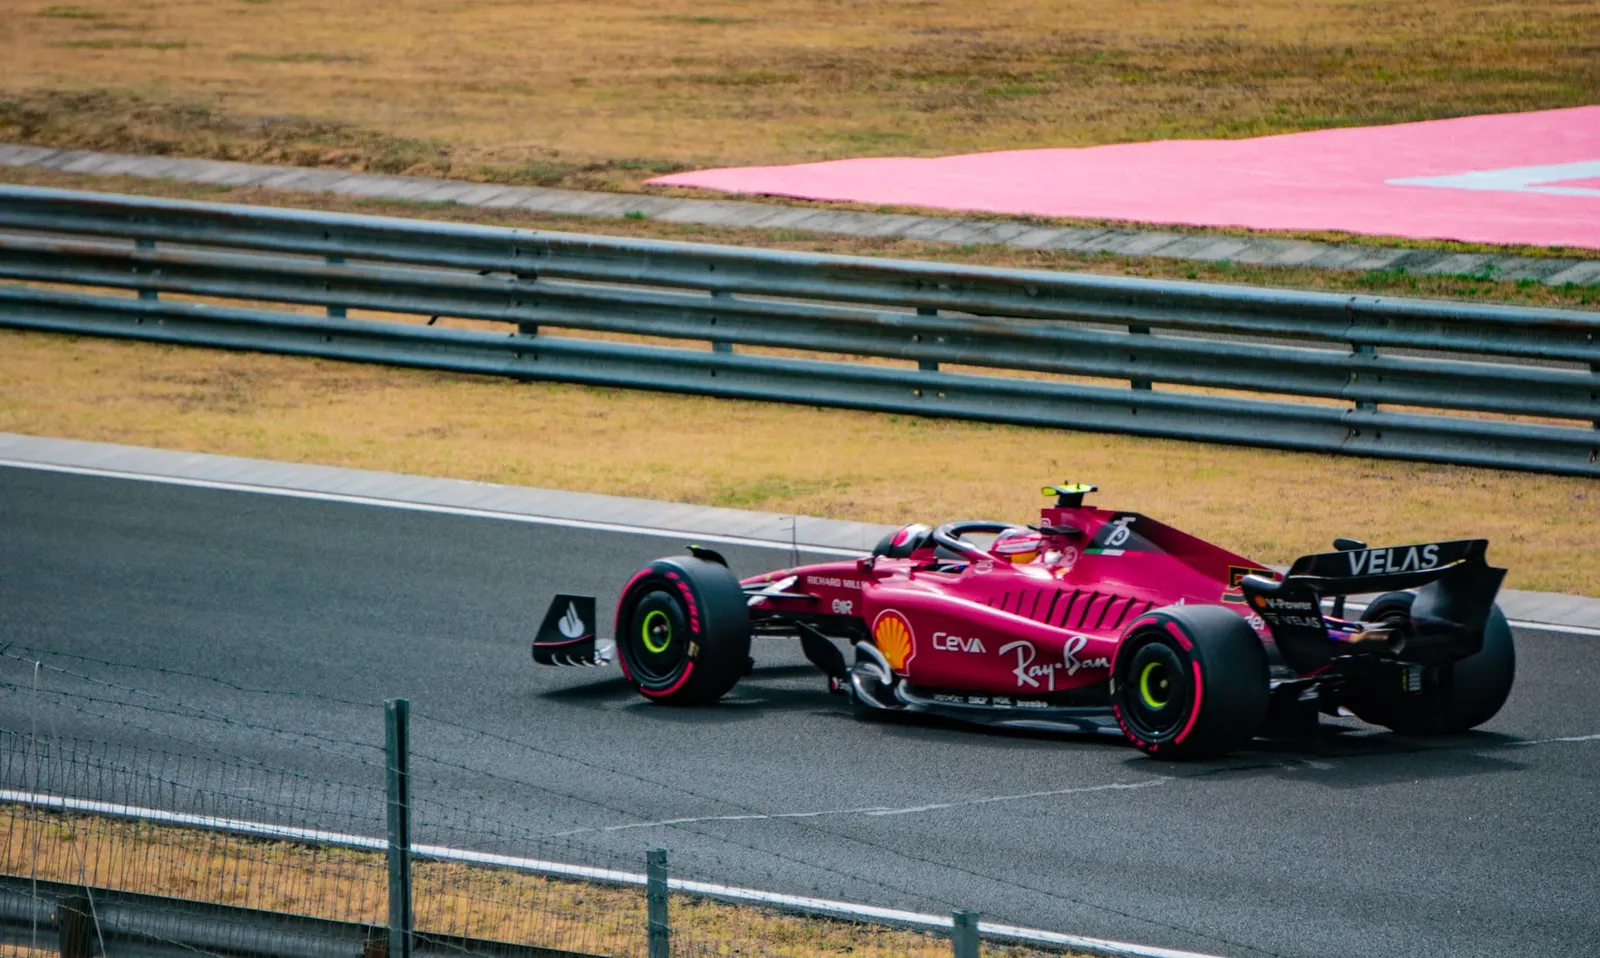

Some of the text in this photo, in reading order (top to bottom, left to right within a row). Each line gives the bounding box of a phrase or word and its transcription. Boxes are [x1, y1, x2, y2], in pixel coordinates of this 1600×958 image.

[1348, 544, 1440, 576] VELAS
[807, 575, 842, 588] RICHARD
[1265, 597, 1312, 610] V-Power
[1280, 615, 1322, 629] VELAS
[999, 635, 1111, 691] Ray-Ban
